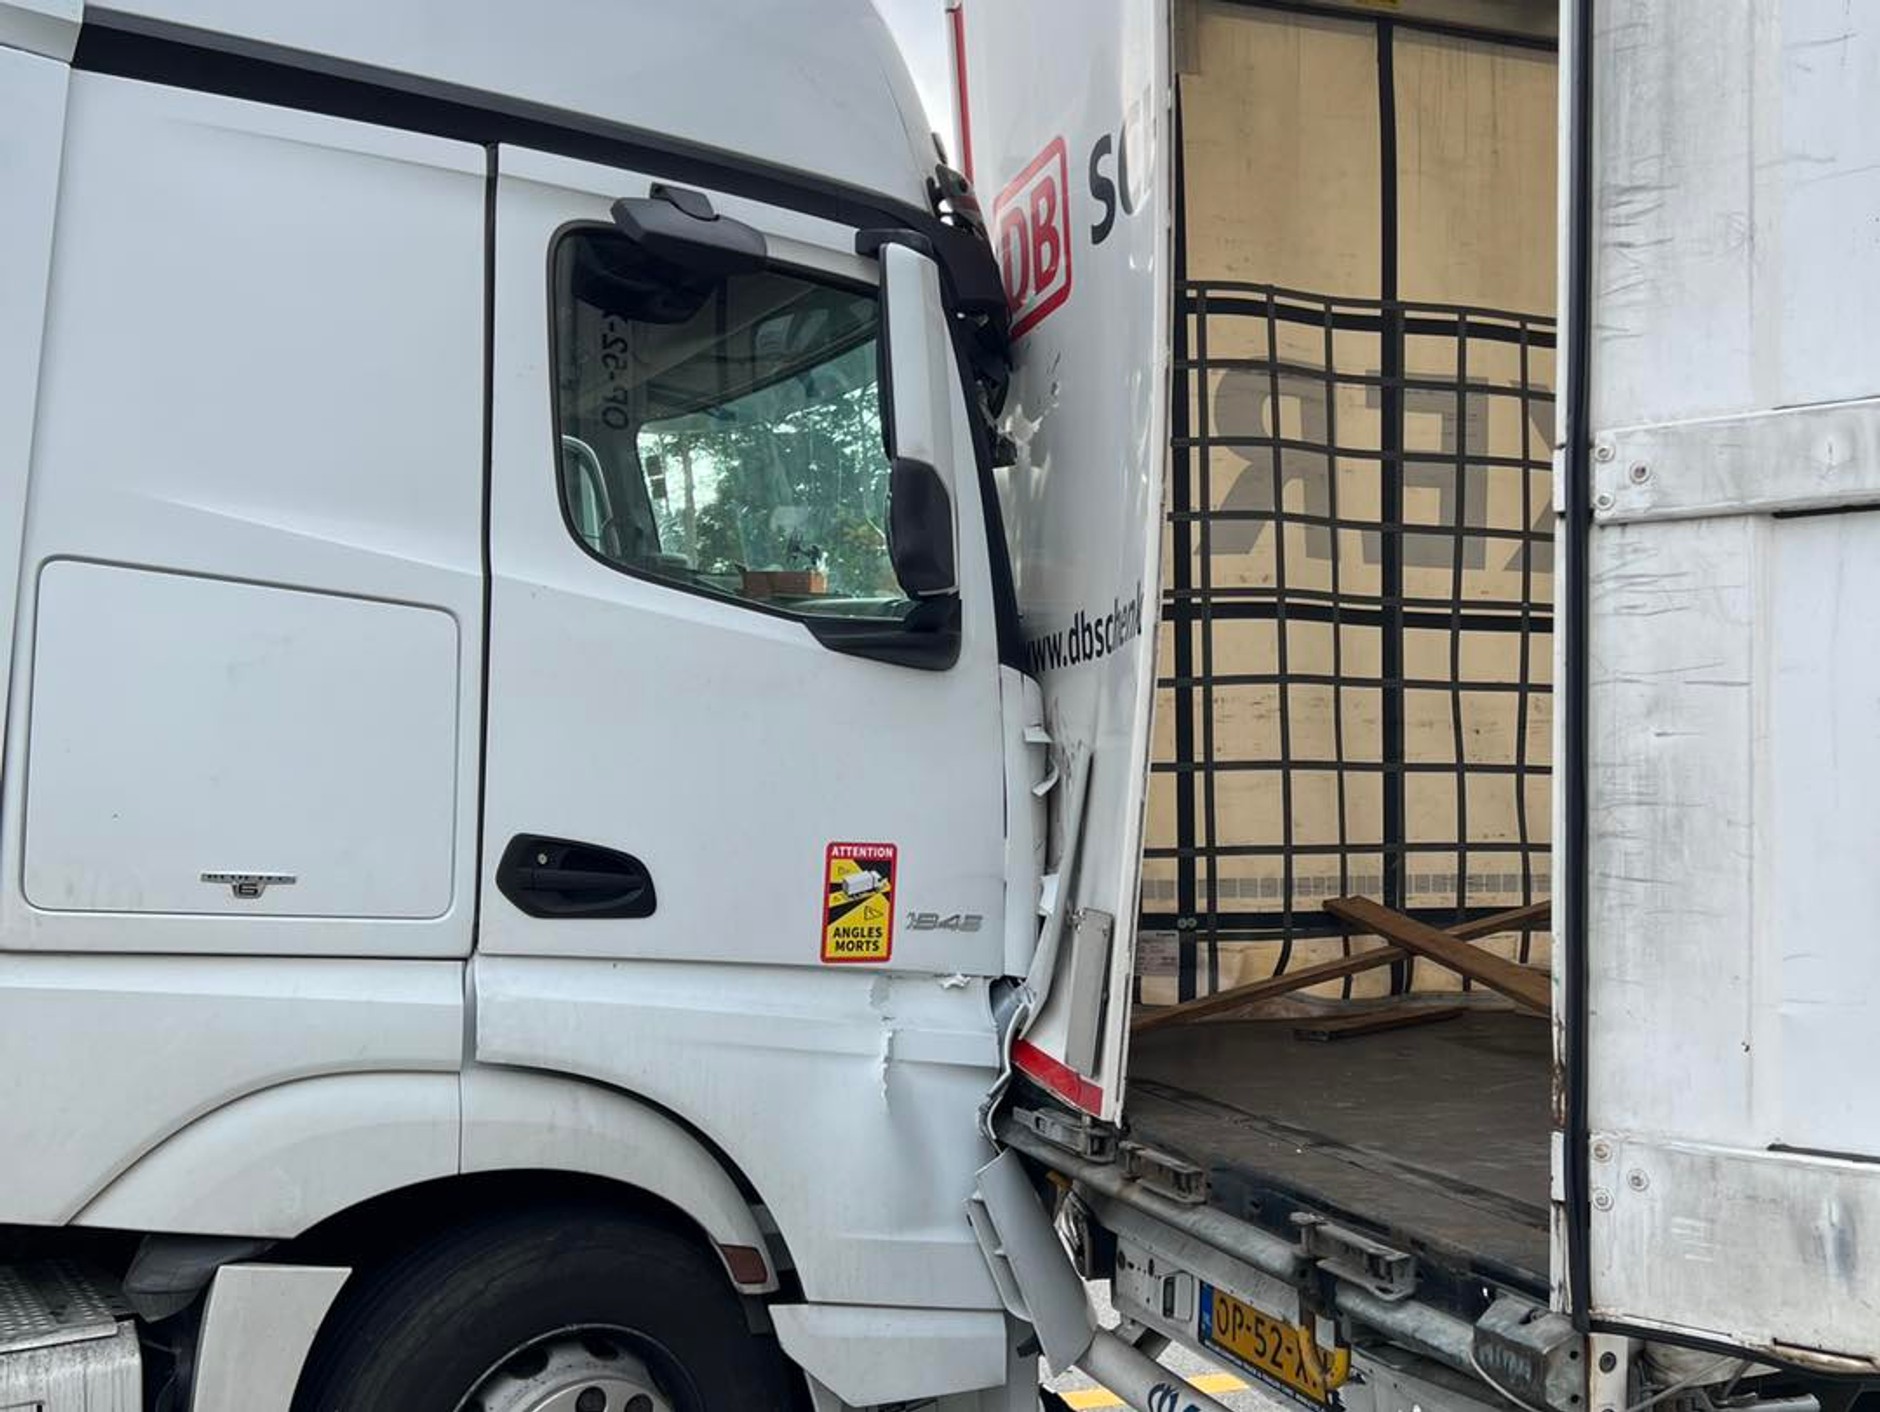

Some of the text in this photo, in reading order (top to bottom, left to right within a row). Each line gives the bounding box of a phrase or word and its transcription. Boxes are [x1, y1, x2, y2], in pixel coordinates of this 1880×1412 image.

[1001, 174, 1060, 315] DB
[831, 846, 893, 858] ATTENTION
[833, 926, 883, 939] ANGLES
[834, 940, 880, 952] MORTS
